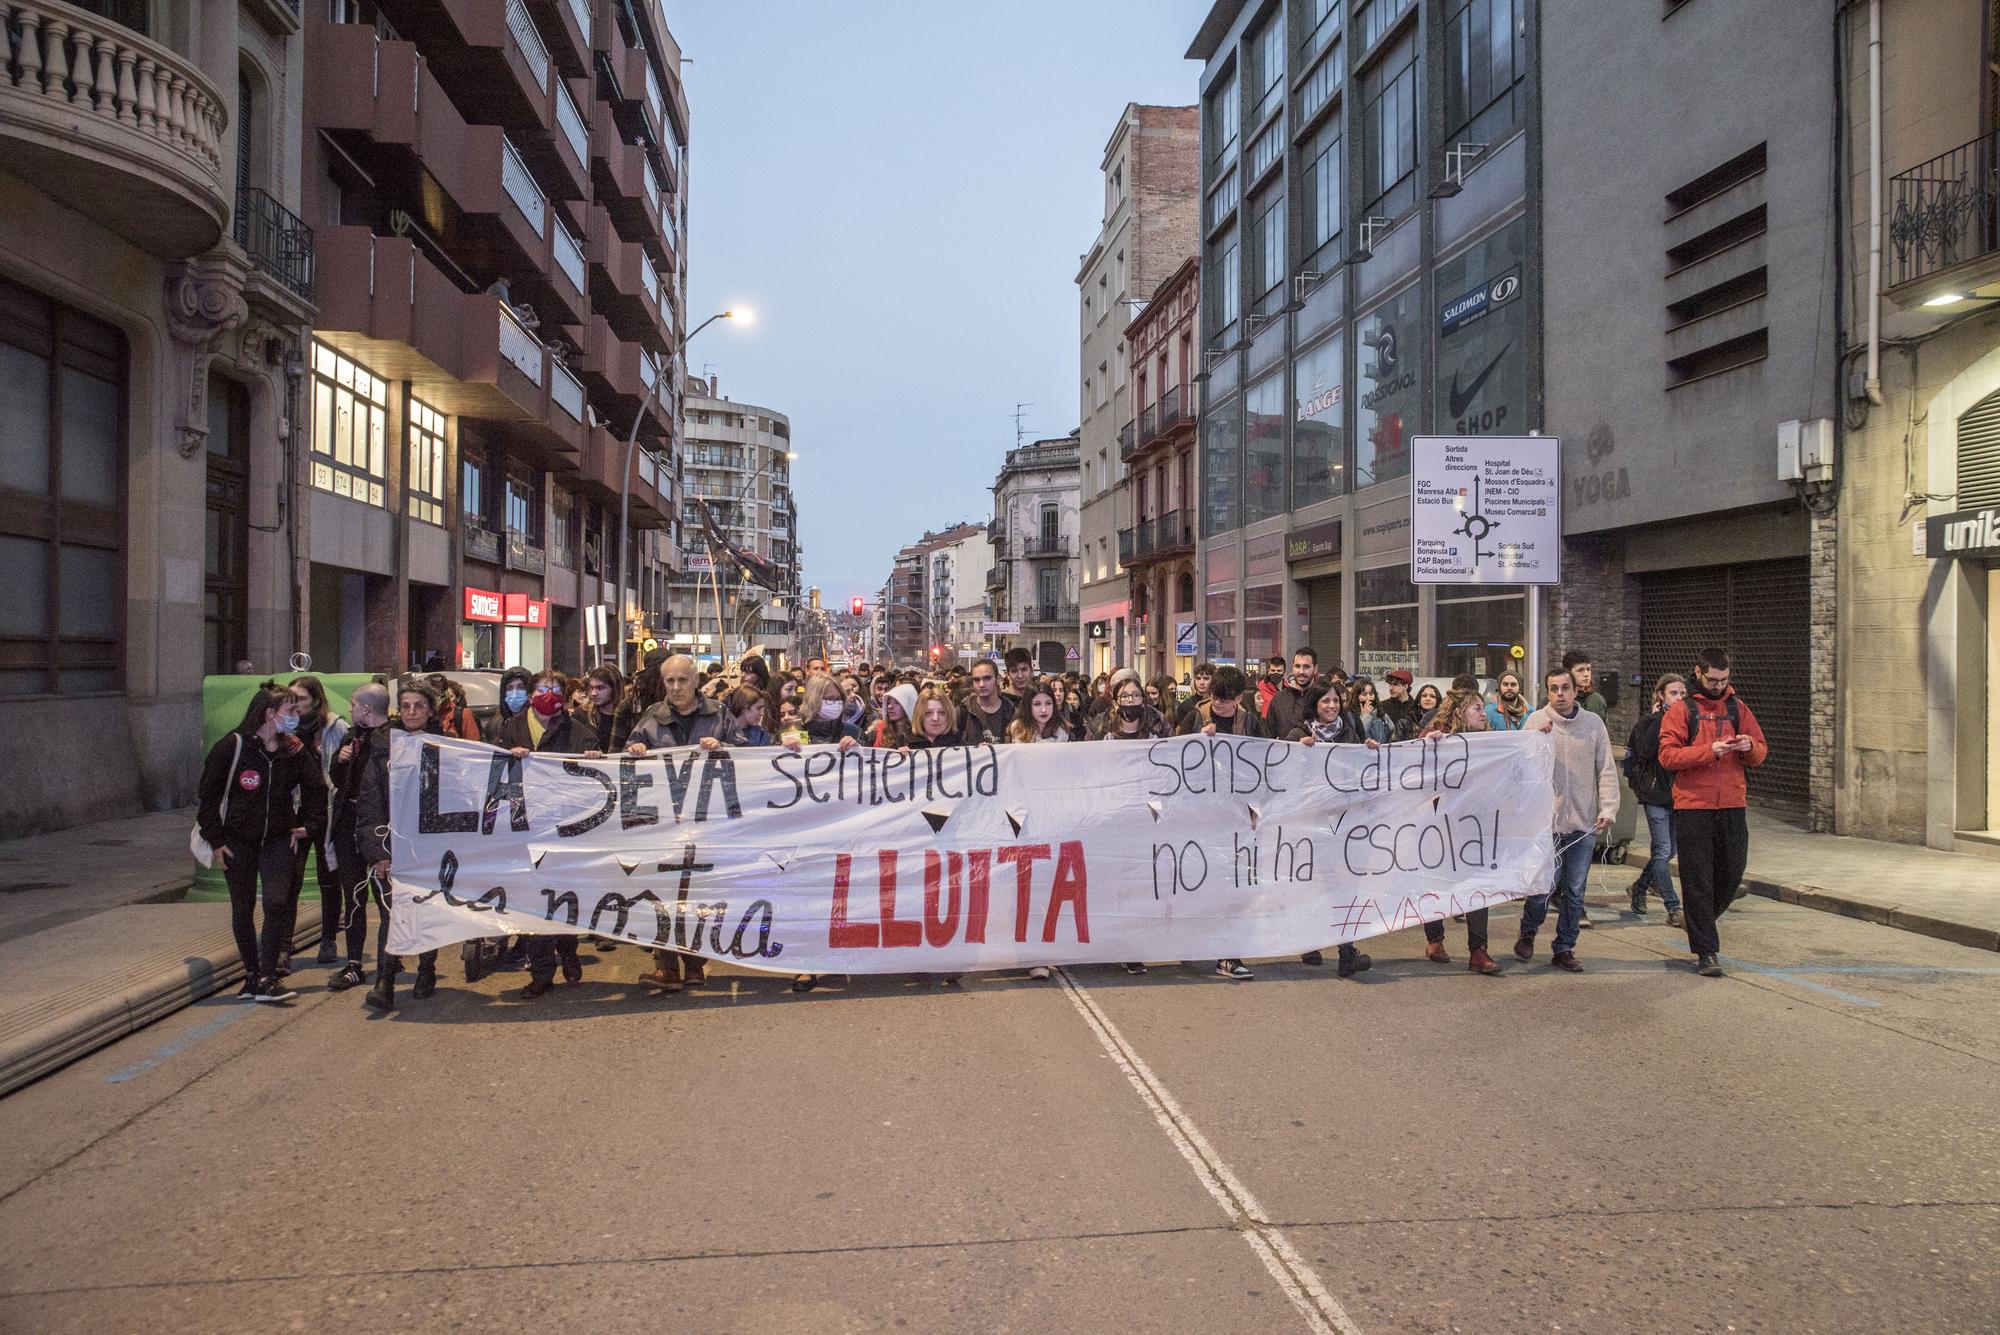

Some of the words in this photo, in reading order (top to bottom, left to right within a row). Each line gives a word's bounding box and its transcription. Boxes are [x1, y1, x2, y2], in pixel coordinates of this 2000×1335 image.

[1443, 289, 1487, 322] SALOMON
[1297, 384, 1341, 422] LANGE
[1456, 405, 1507, 436] SHOP
[1445, 445, 1468, 453] Sortida
[1445, 455, 1464, 463] Altres
[1484, 459, 1511, 467] Hospital
[318, 468, 327, 485] 93
[1573, 467, 1632, 507] YOGA
[1417, 497, 1441, 505] Estació
[1511, 498, 1546, 506] Municipals
[1417, 538, 1446, 547] Pàrquing
[1521, 542, 1535, 550] Sud
[1432, 557, 1452, 565] Bages
[1148, 739, 1291, 796] sense
[419, 743, 531, 835] LA
[556, 750, 744, 837] SEVA
[1153, 839, 1208, 900] no
[1234, 831, 1259, 888] hi
[1274, 824, 1314, 883] ha
[1344, 809, 1498, 876] escola!
[828, 840, 1090, 949] LLUITA
